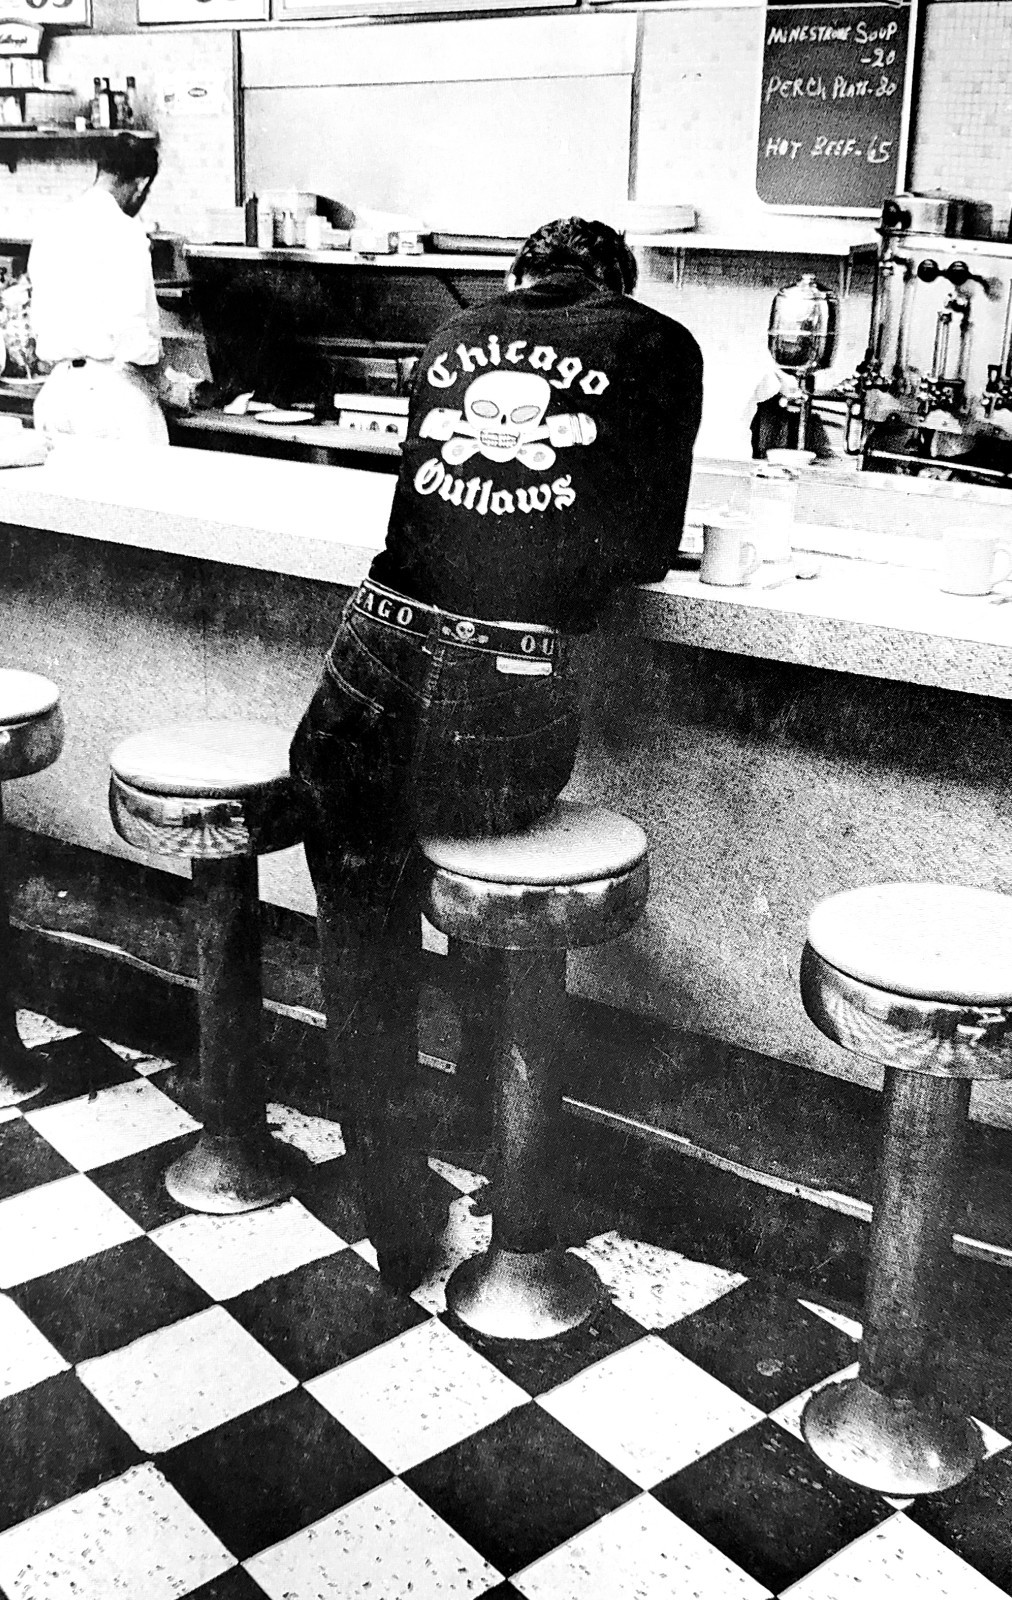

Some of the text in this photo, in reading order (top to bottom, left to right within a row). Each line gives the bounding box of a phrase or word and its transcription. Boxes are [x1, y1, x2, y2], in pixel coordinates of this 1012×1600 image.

[860, 48, 897, 68] -20
[765, 137, 802, 160] HOT
[427, 334, 610, 395] Chicago
[413, 457, 577, 516] Outlaws
